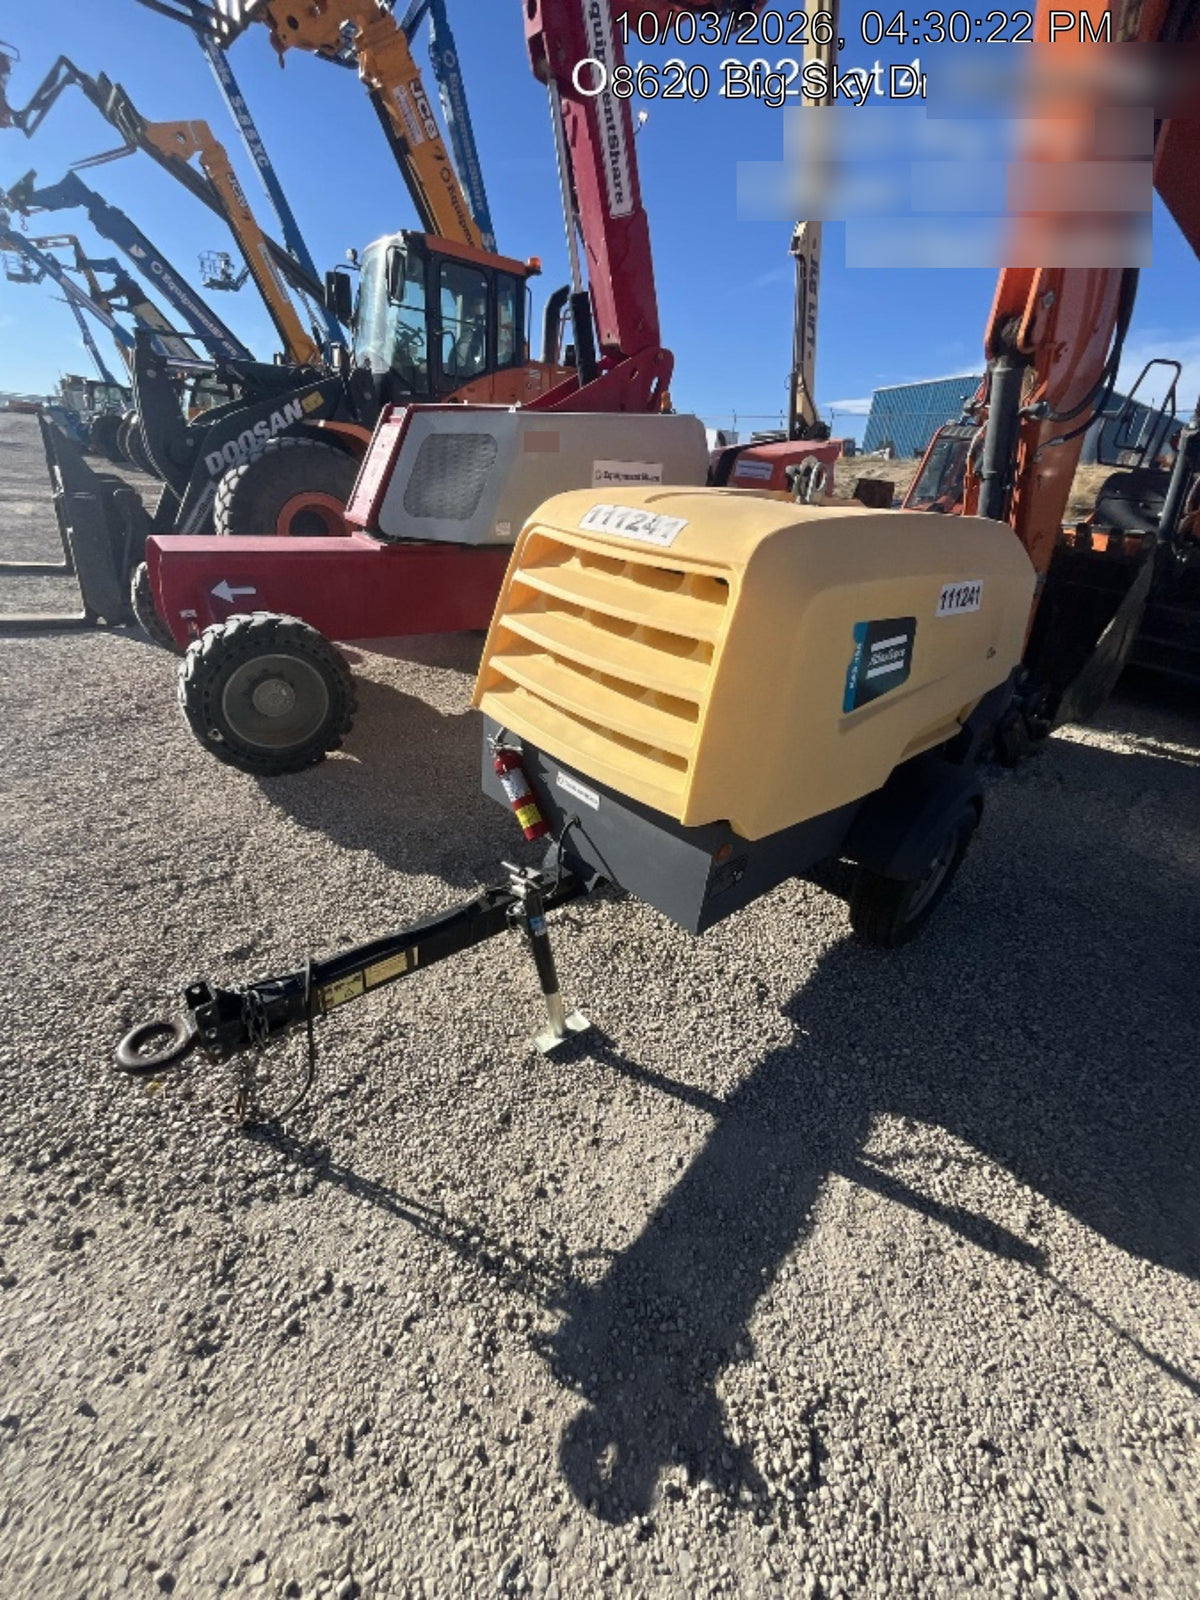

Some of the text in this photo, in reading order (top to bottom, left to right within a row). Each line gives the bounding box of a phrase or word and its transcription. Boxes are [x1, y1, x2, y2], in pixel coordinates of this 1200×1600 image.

[409, 78, 440, 140] JCB
[586, 0, 624, 204] quipentShare
[807, 253, 819, 348] JLG LIFT
[205, 398, 303, 475] DOOSAN
[587, 506, 679, 539] 111241
[939, 585, 981, 610] 111241
